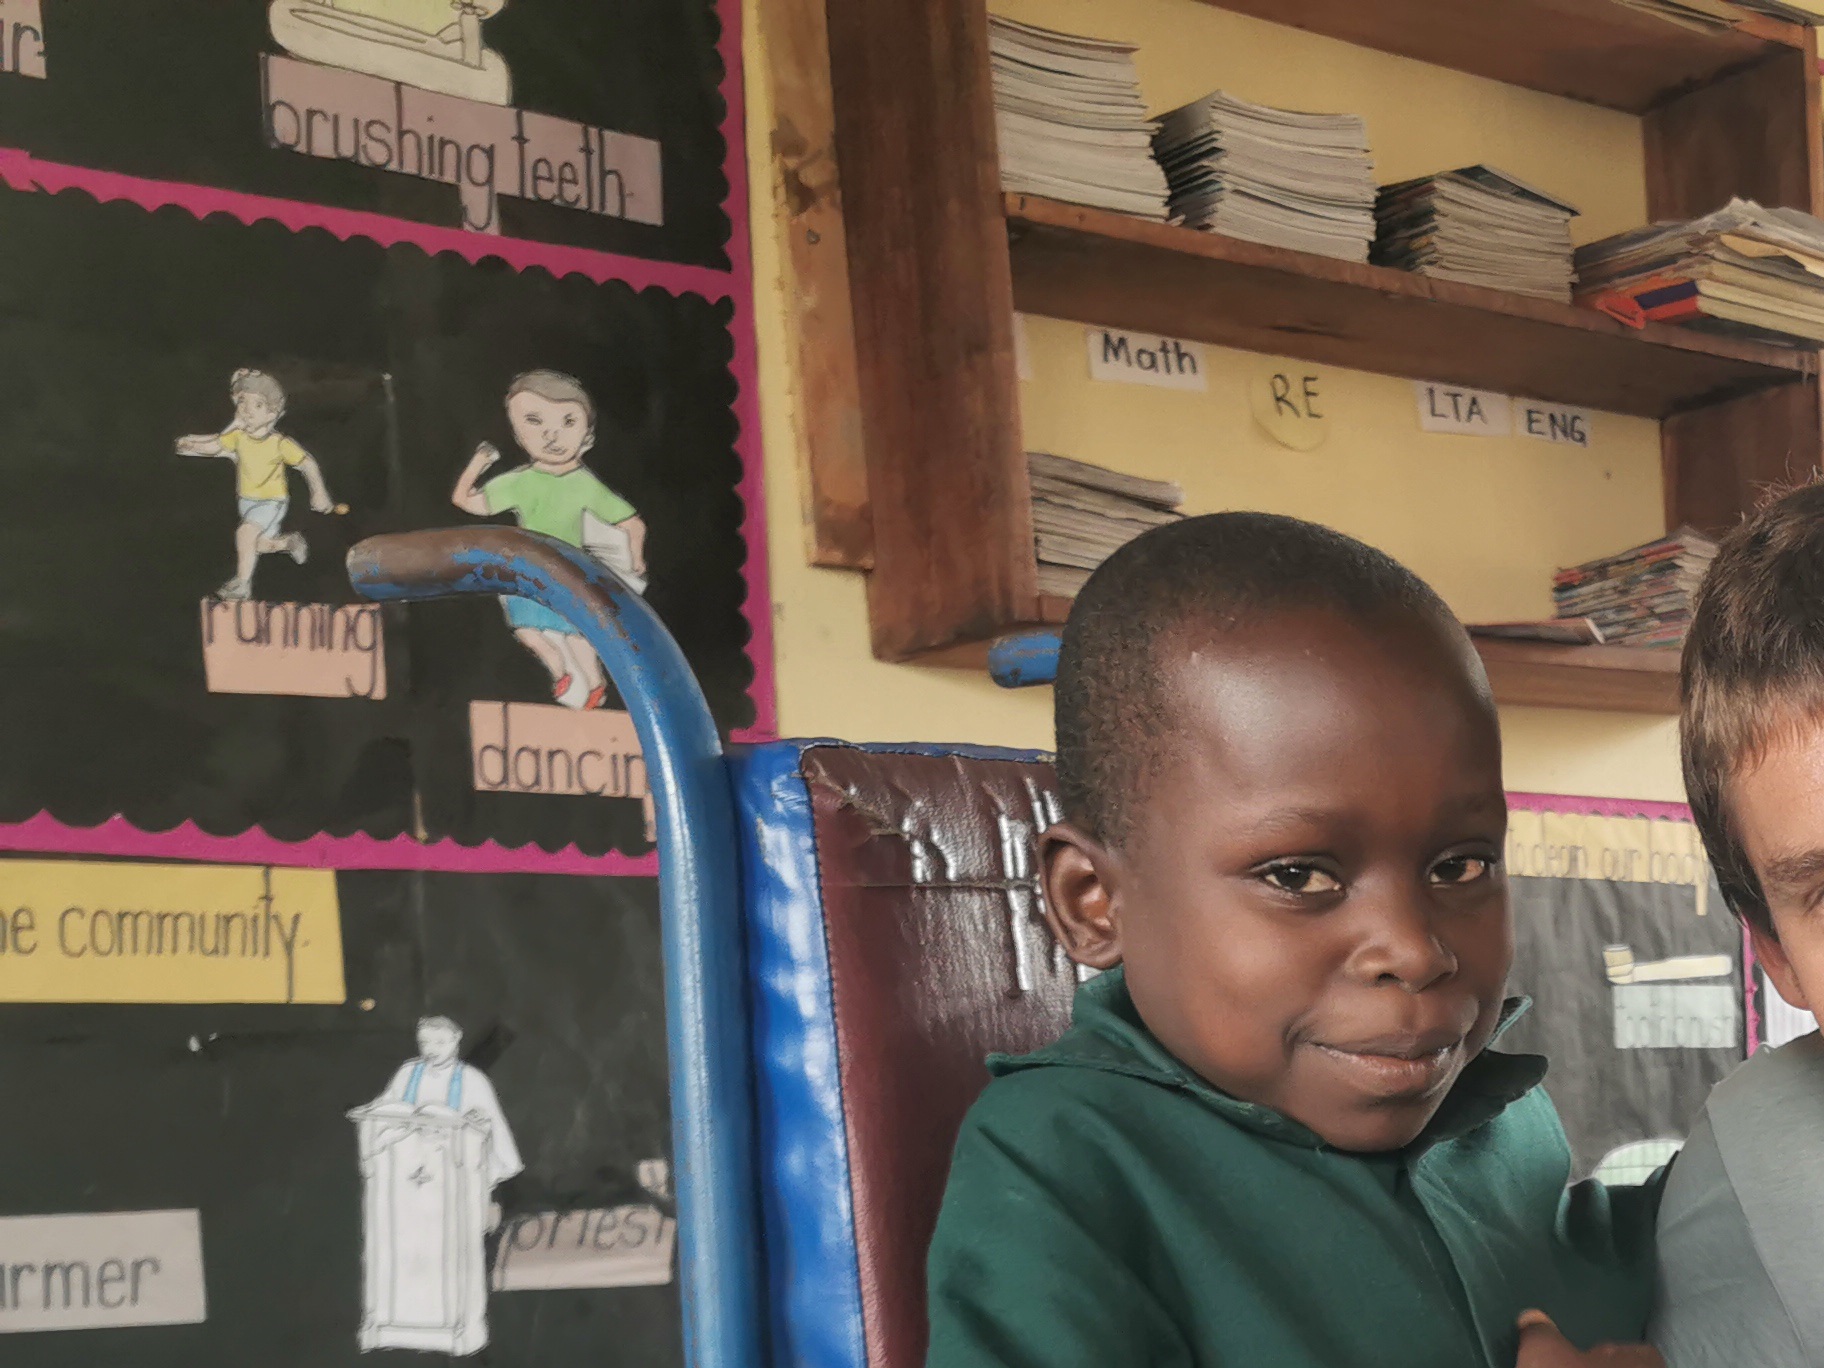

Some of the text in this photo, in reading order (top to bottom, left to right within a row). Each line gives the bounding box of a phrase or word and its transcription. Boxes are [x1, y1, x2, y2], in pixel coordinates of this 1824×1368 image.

[261, 54, 626, 231] brushing teeth
[1102, 332, 1198, 374] Math
[1270, 374, 1324, 419] RE
[1425, 387, 1487, 424] LTA
[1527, 410, 1588, 446] ENG
[206, 602, 383, 693] running
[478, 703, 649, 793] dancin
[58, 867, 302, 1001] community
